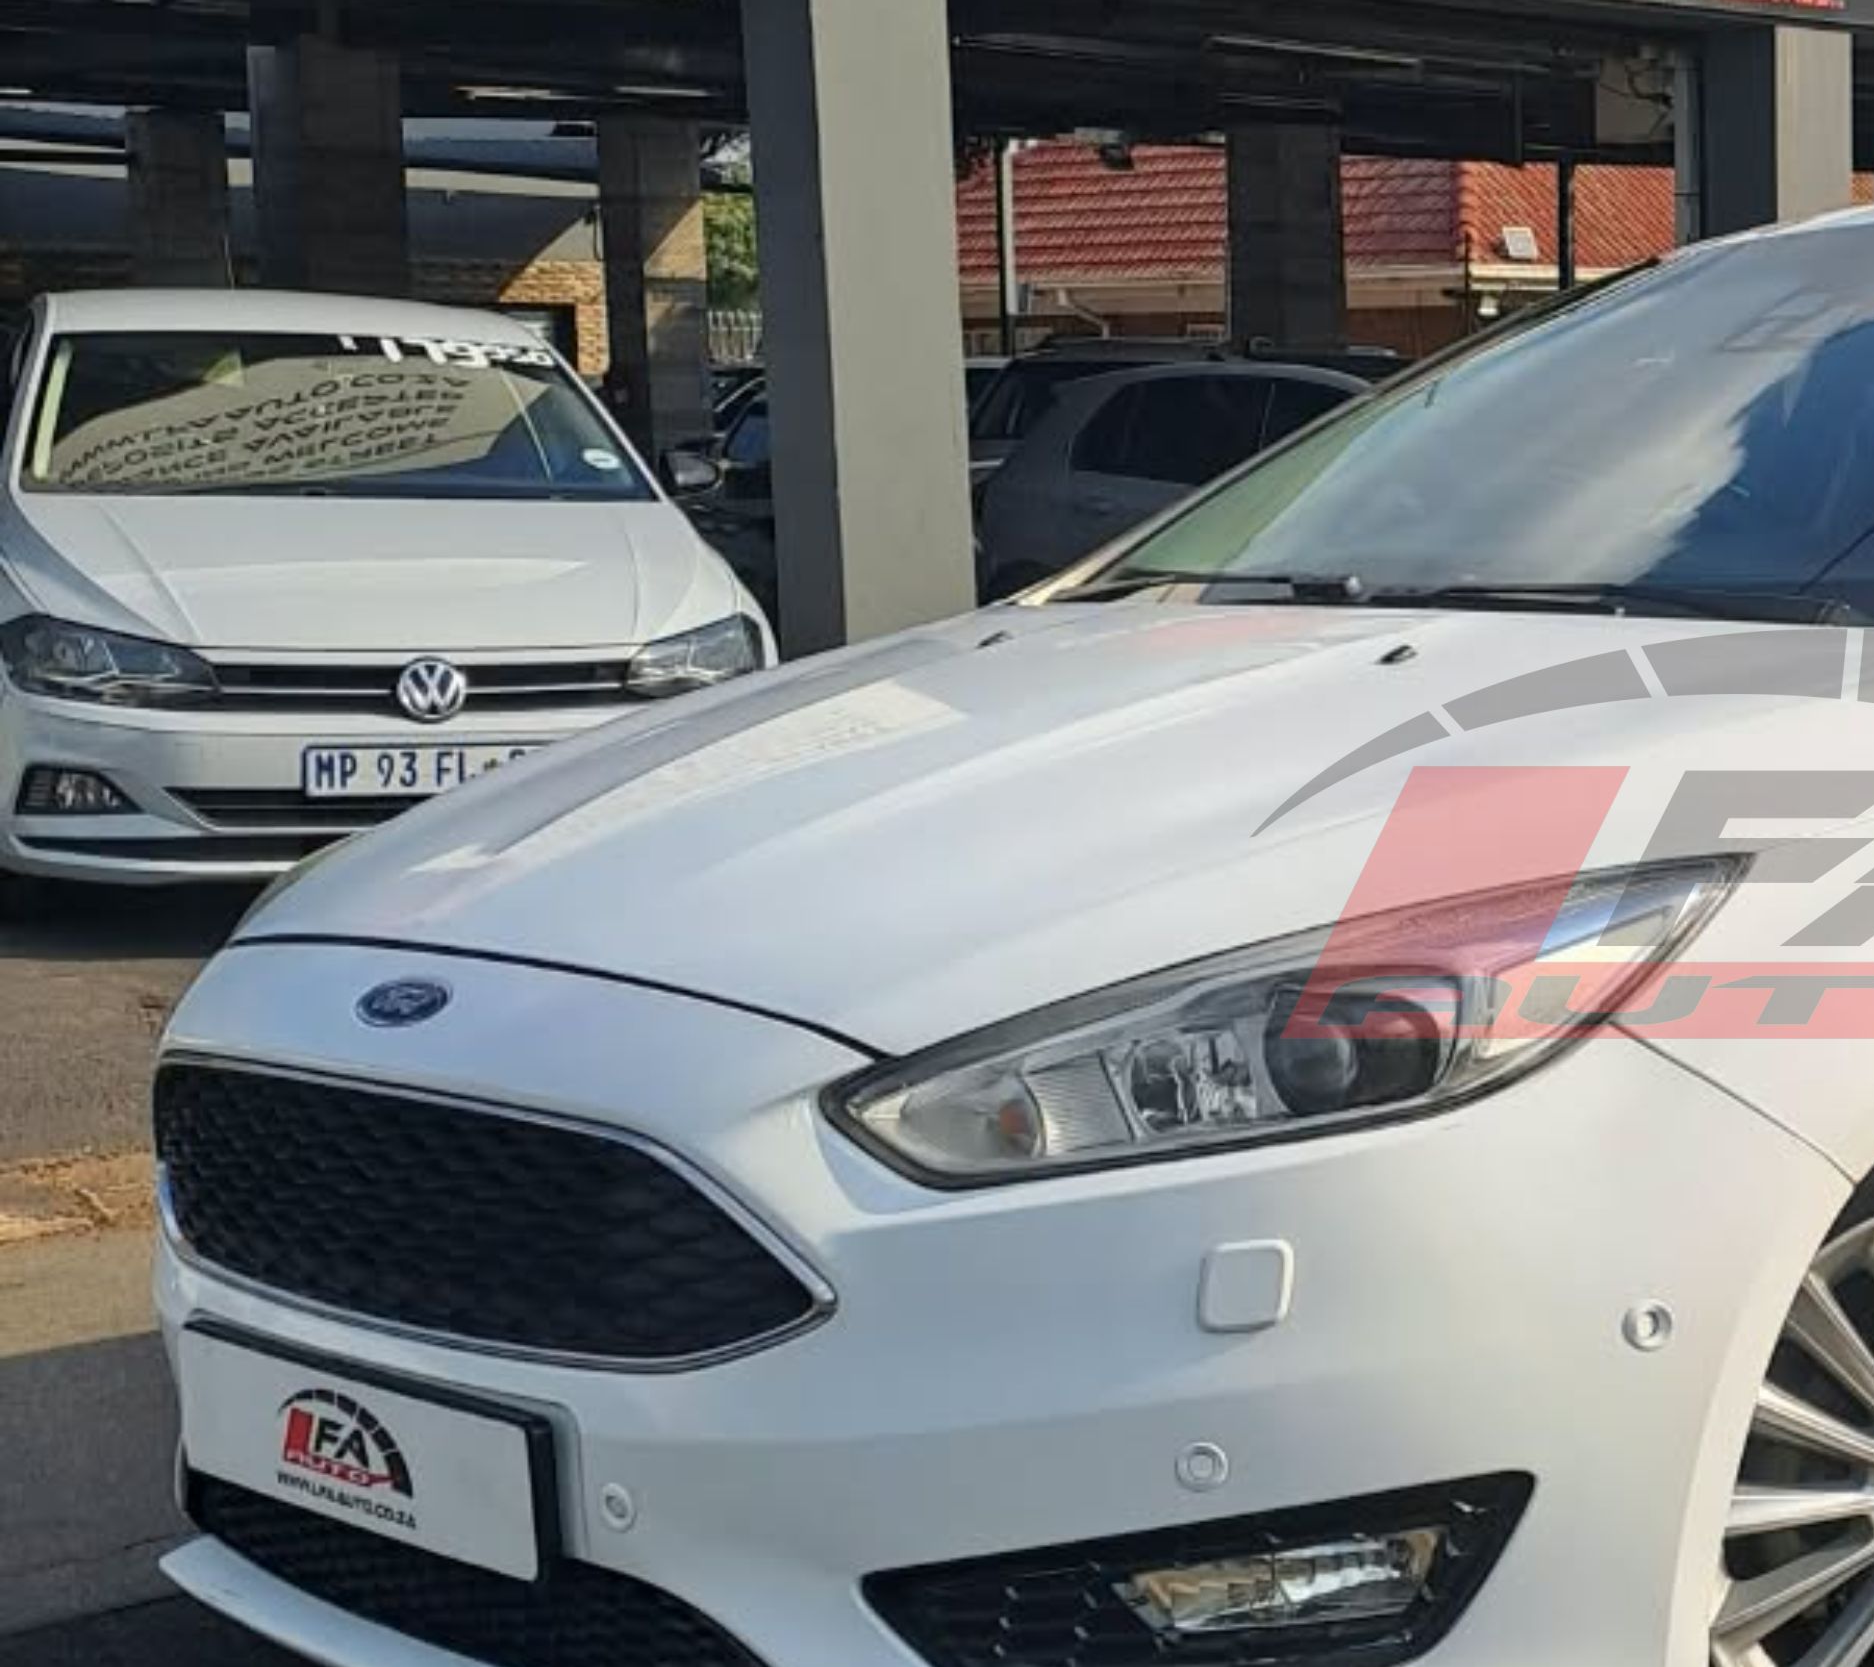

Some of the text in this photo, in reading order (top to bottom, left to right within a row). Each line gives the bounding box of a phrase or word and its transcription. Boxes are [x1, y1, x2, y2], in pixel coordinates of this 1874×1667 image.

[314, 750, 358, 790] MP
[376, 750, 418, 789] 93
[286, 1450, 371, 1486] AUTO
